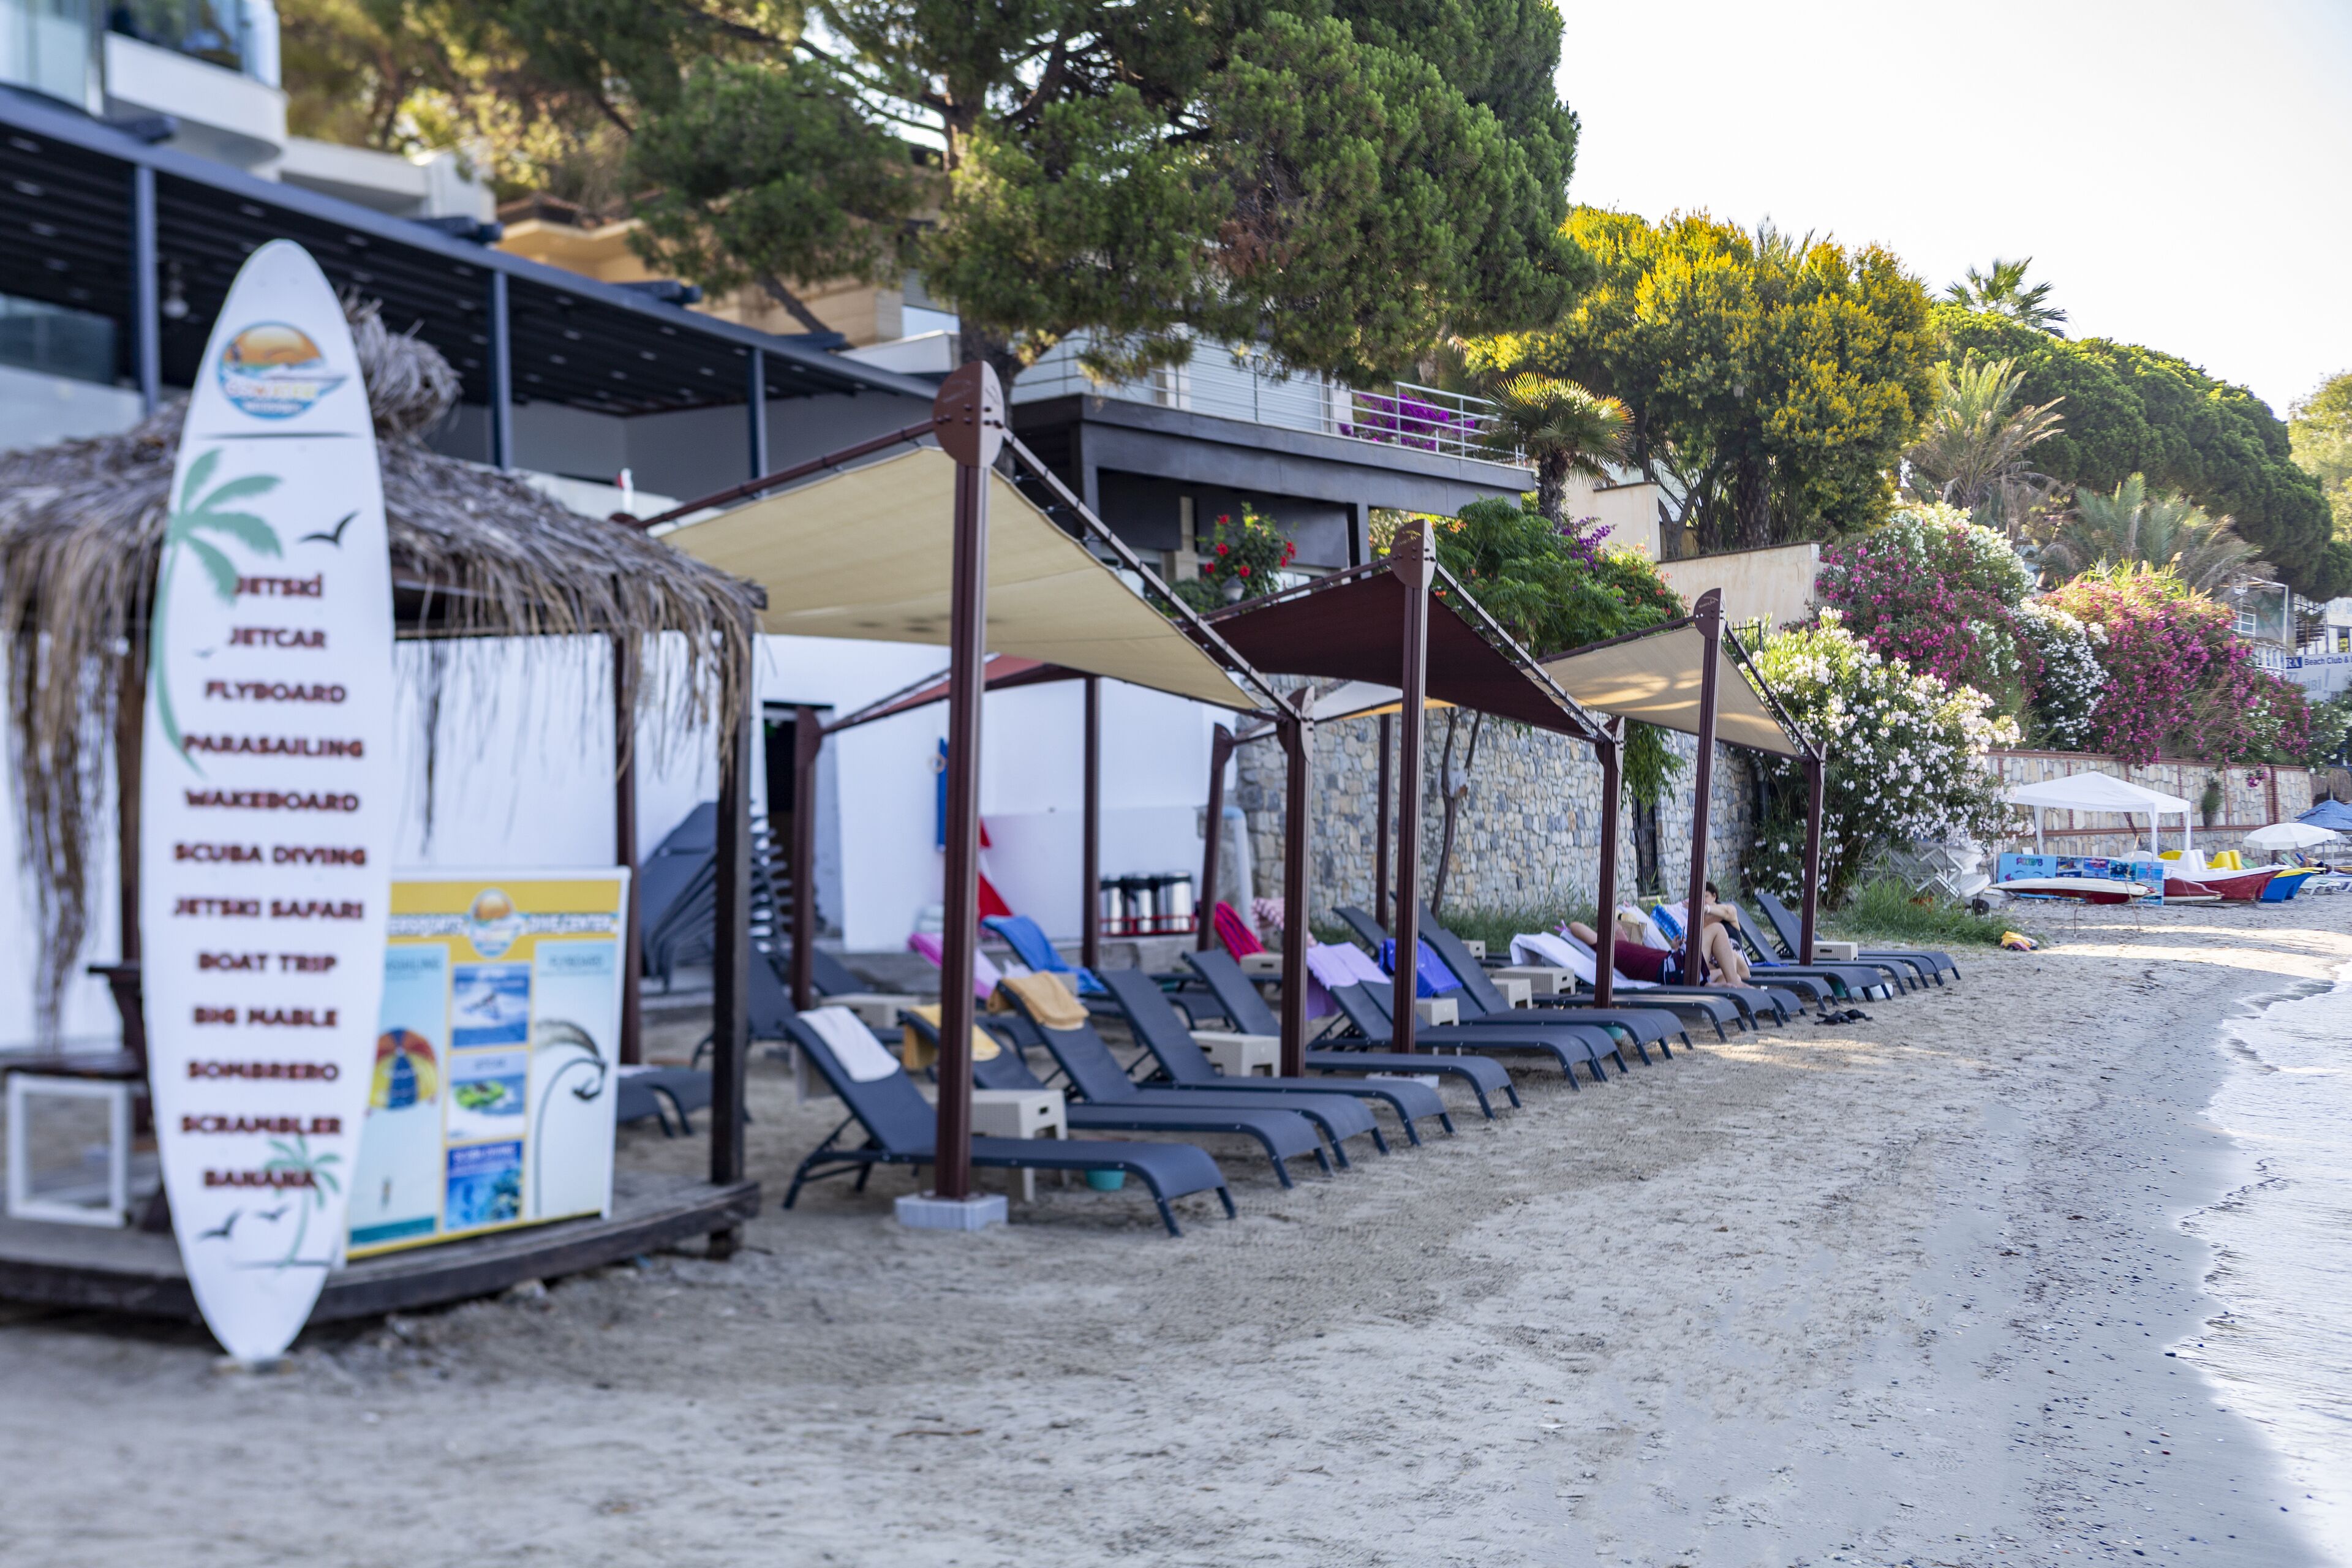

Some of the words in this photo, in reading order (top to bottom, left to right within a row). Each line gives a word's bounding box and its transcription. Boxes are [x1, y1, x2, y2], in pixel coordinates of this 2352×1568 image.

[230, 627, 326, 649] JETCAR
[205, 680, 347, 703] FLYBOARD
[184, 734, 364, 759] PARASAILING
[185, 790, 360, 812] WAKEBOARD
[175, 843, 263, 863] SCUBA
[273, 845, 366, 866] DIVING
[175, 898, 261, 918] JETSKI
[271, 900, 363, 919] SAFARI
[198, 952, 268, 971] BOAT
[279, 954, 337, 972] TRIP
[193, 1006, 237, 1025] BIG
[247, 1009, 337, 1027] MABLE
[188, 1061, 339, 1082] SOMBRERO
[182, 1115, 341, 1134] SCRAMBLER
